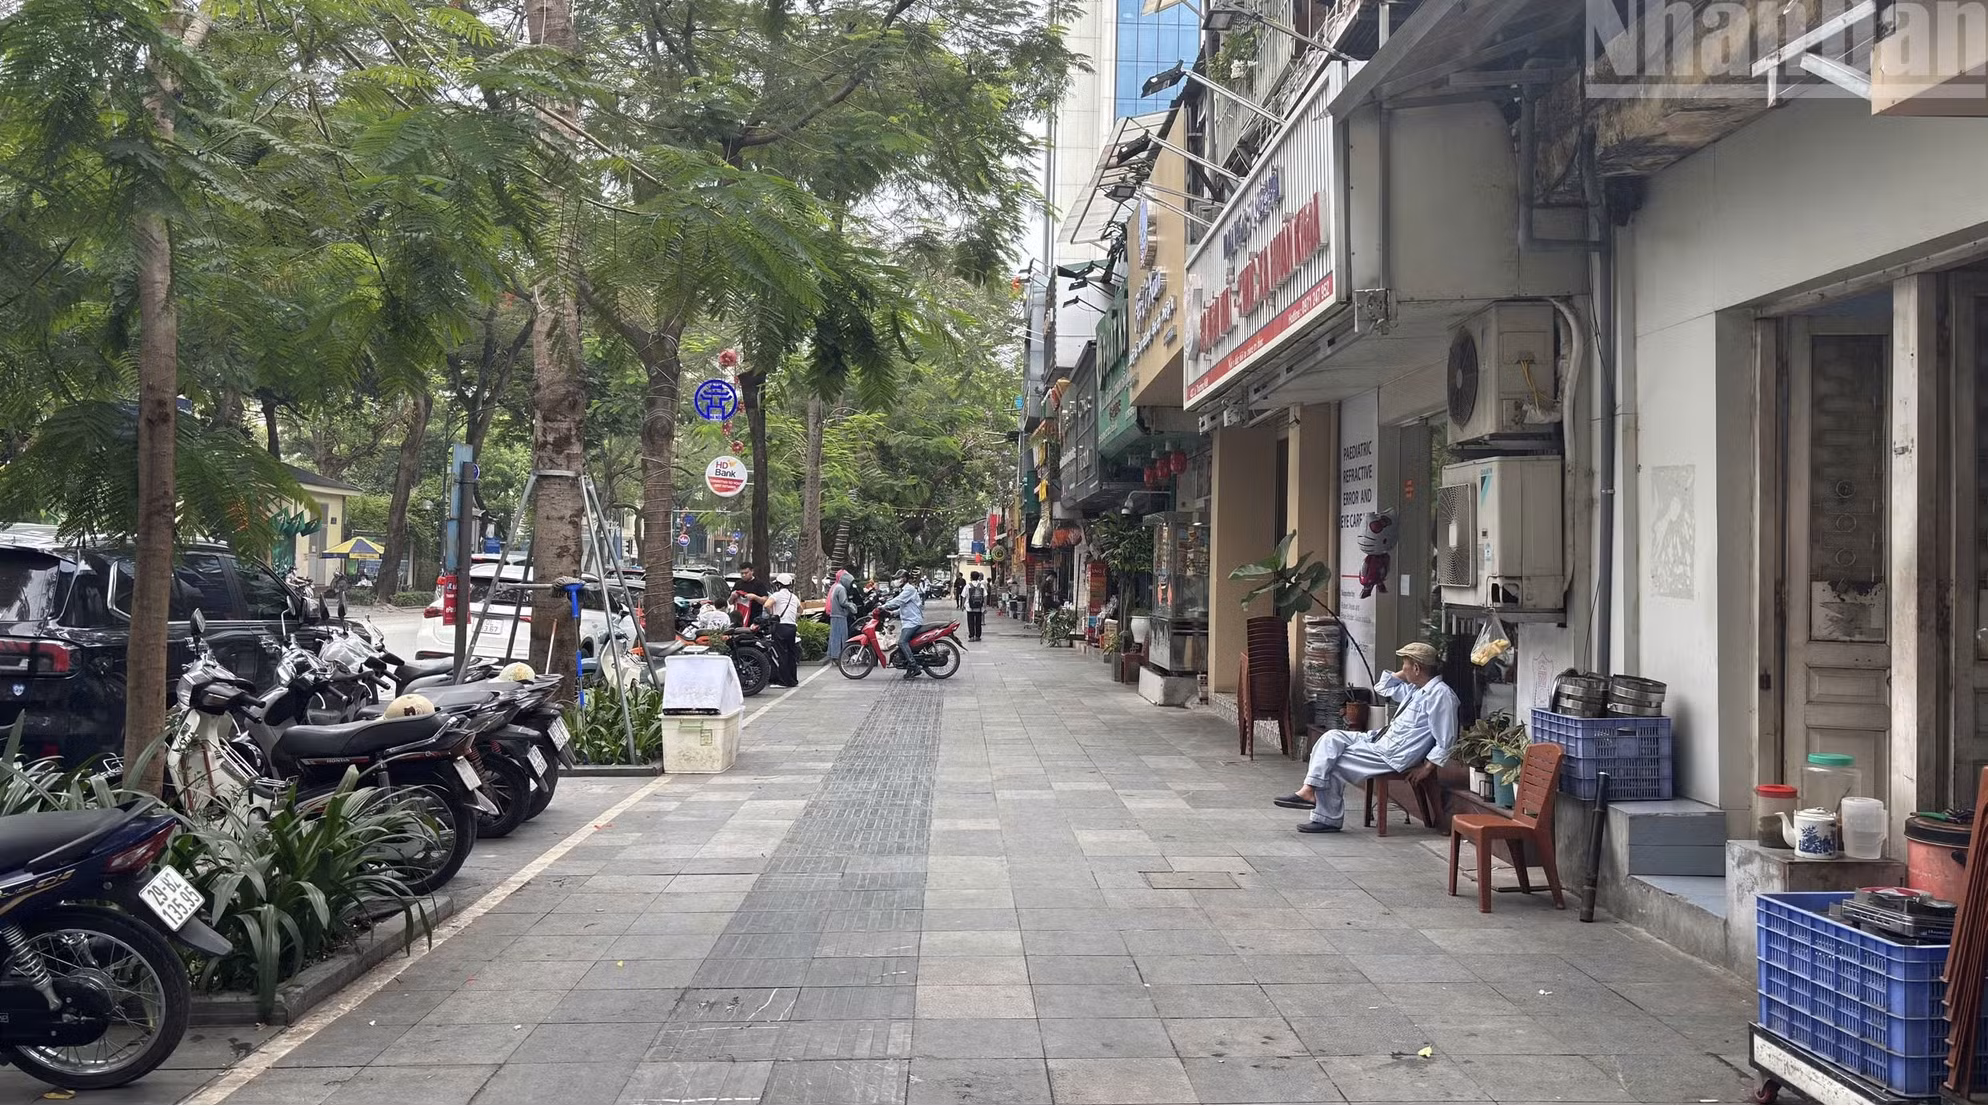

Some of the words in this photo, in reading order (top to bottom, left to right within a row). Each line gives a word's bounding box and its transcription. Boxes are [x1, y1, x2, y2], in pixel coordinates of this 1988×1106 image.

[1343, 441, 1372, 461] PAEDIATRIC
[715, 468, 736, 478] Bank
[716, 461, 728, 469] HD
[1343, 464, 1372, 483] REFRACTIVE
[1343, 490, 1359, 506] ERROR
[1360, 488, 1372, 504] AND
[1341, 514, 1349, 528] EYE
[162, 885, 200, 925] 135.95
